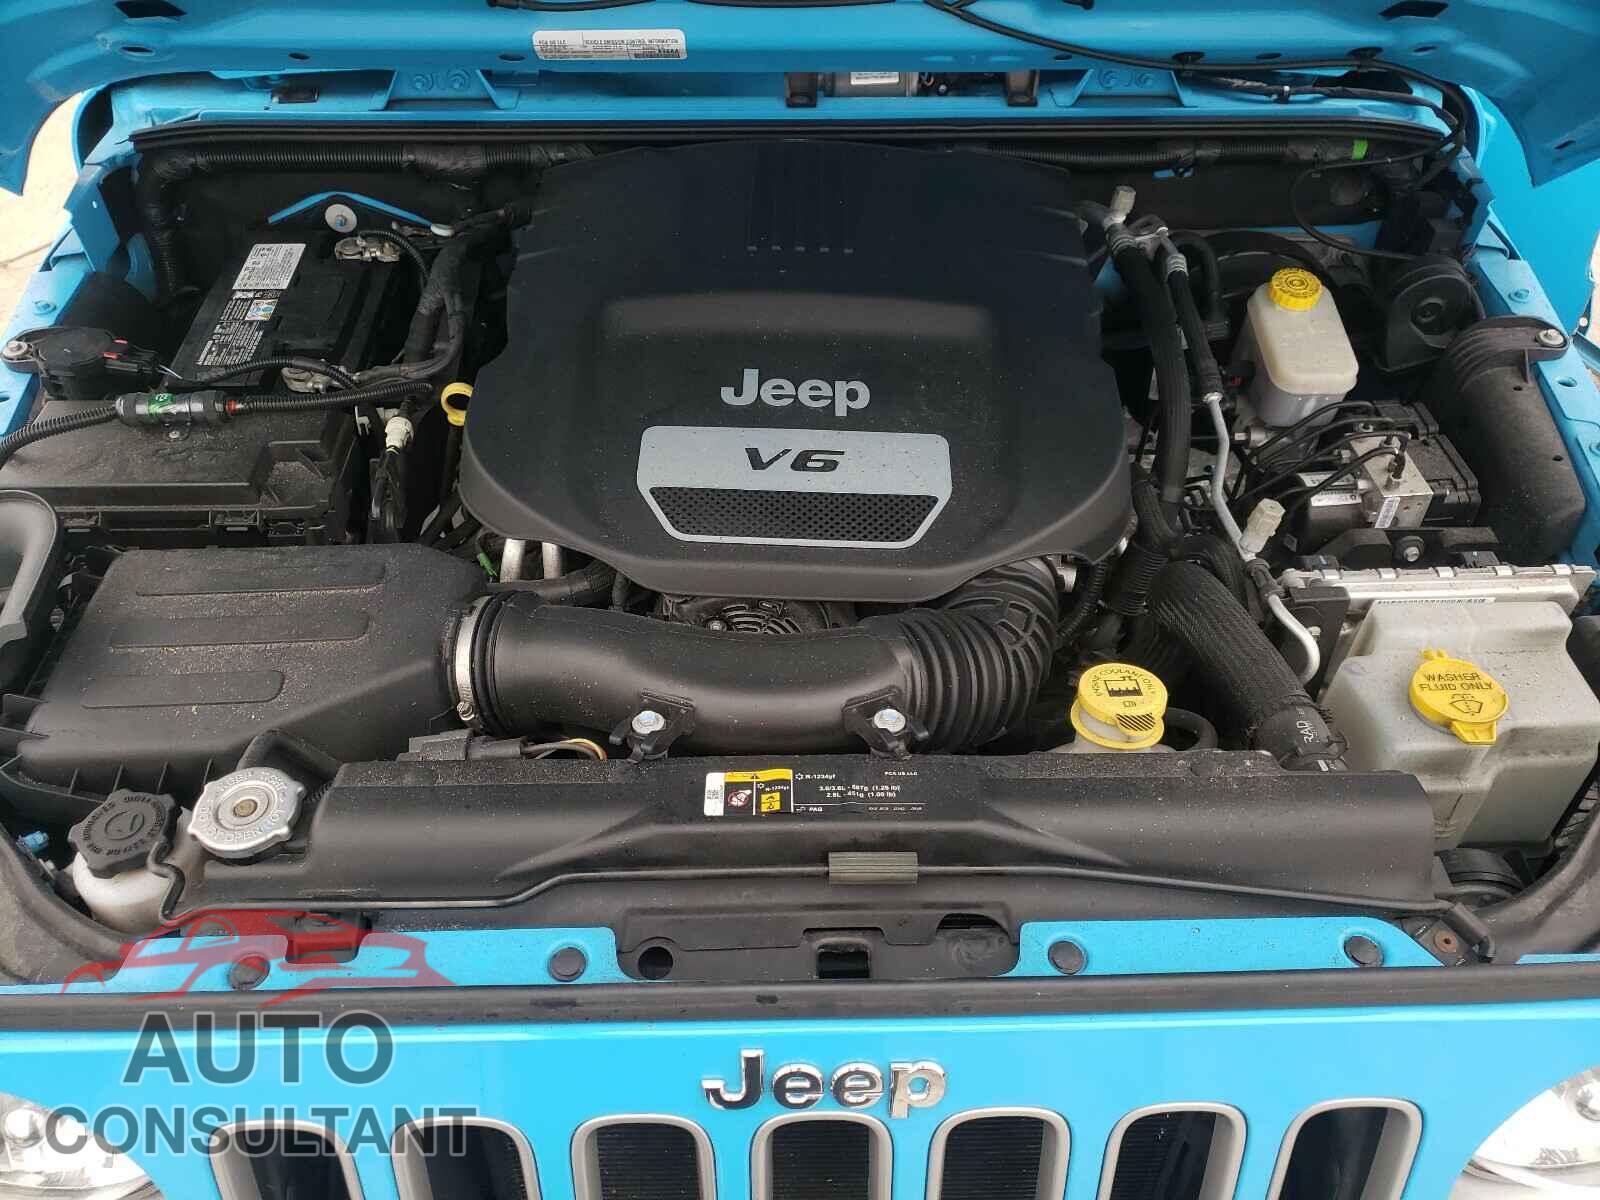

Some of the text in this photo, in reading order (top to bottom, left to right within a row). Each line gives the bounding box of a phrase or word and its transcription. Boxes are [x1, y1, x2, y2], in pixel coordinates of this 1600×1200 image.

[720, 368, 871, 417] Jeep
[745, 447, 846, 473] V6
[1419, 681, 1494, 691] FLUID ONLY
[1423, 672, 1481, 682] WASHER
[701, 1048, 946, 1120] Jeep
